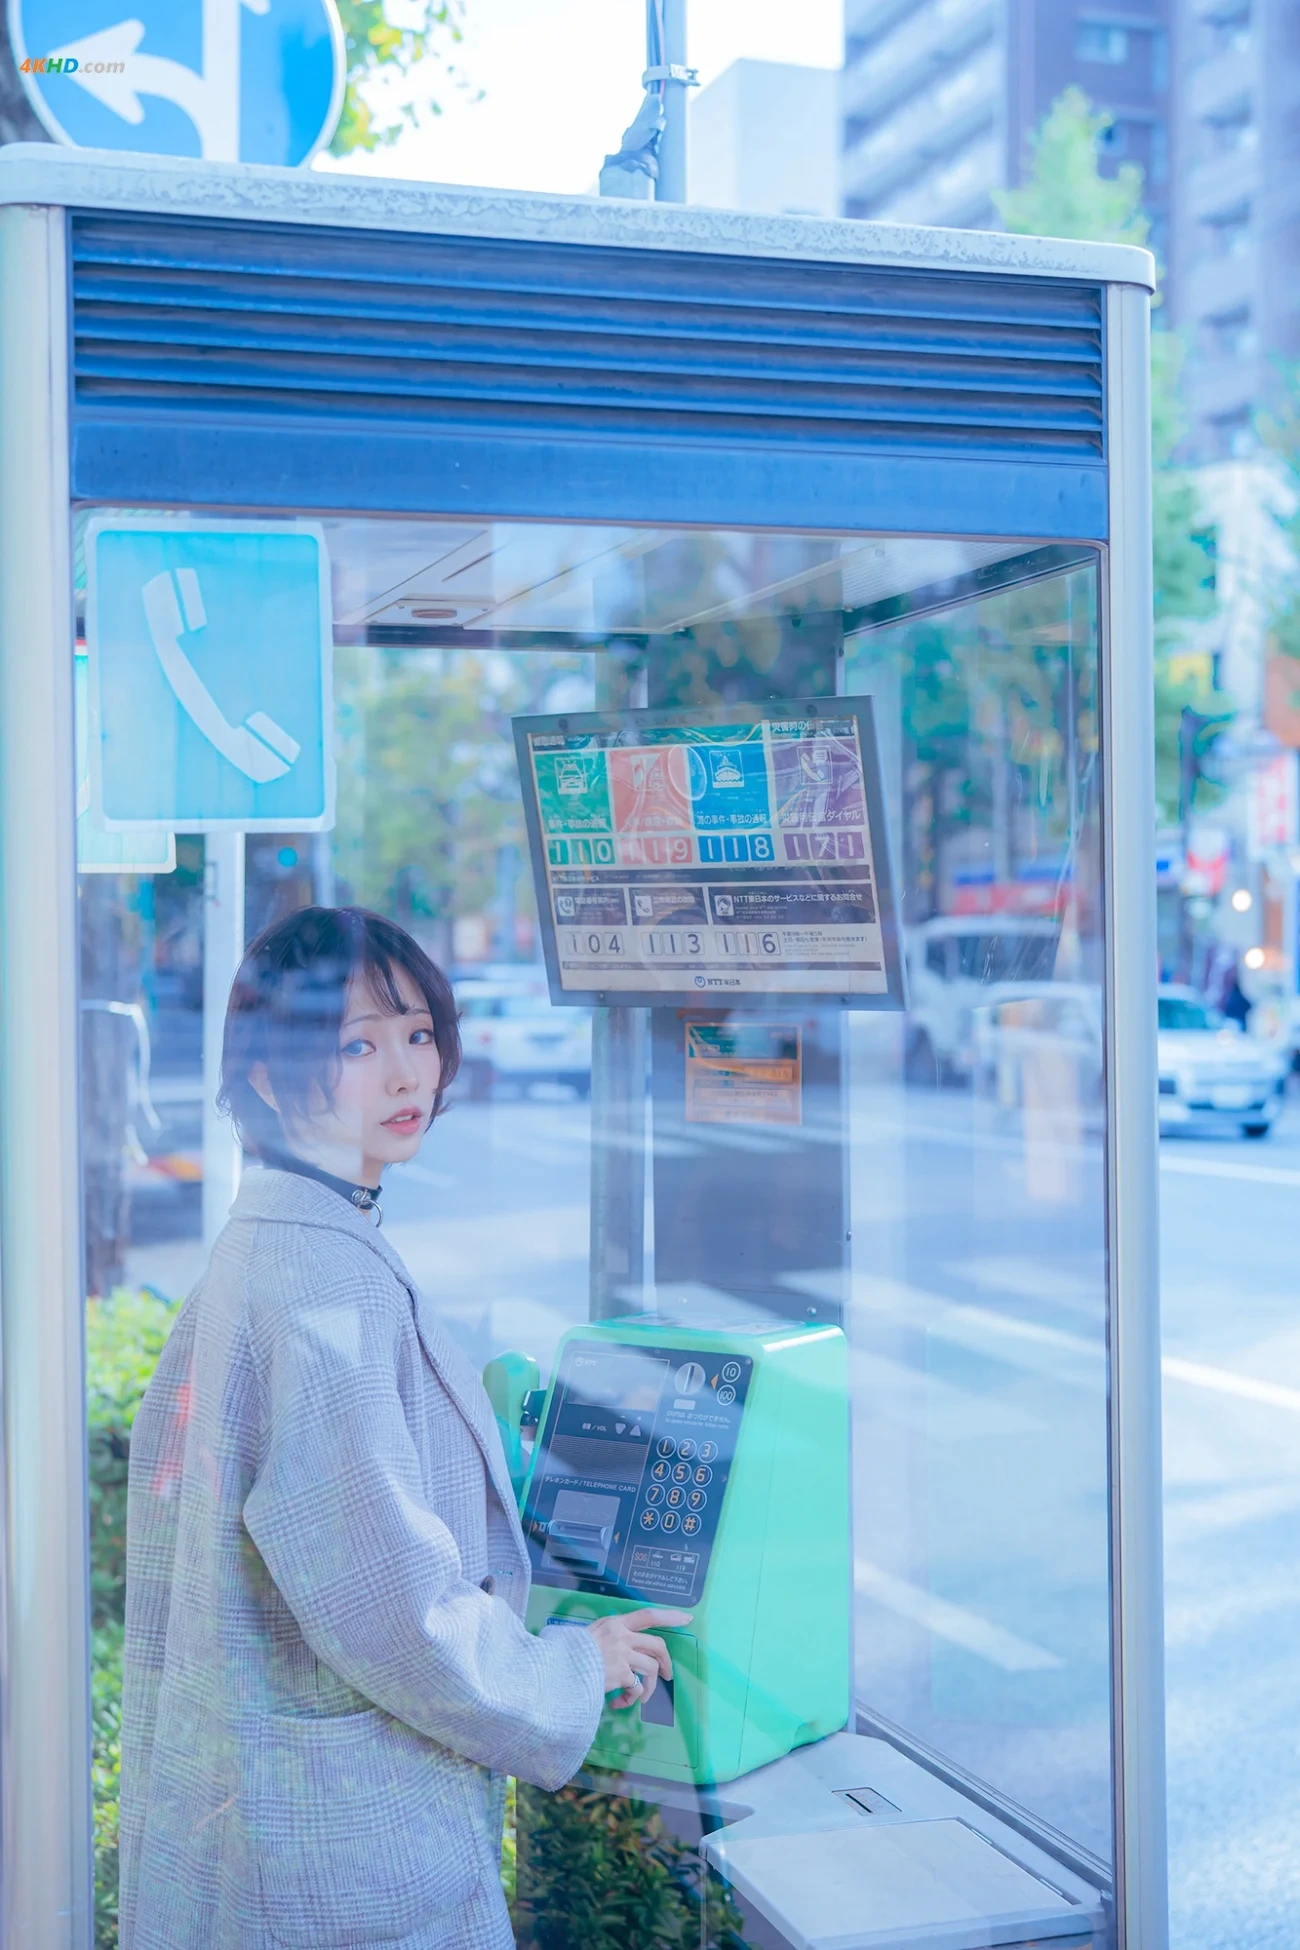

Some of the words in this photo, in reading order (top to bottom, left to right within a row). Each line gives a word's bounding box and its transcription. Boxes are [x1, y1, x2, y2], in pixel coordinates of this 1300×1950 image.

[555, 840, 612, 863] 110
[629, 838, 688, 861] 119
[707, 836, 770, 859] 118
[792, 833, 855, 858] 171
[571, 933, 621, 954] 104
[649, 933, 701, 954] 113
[723, 932, 776, 954] 116
[725, 1367, 737, 1377] 10
[719, 1390, 733, 1401] 100
[634, 1551, 648, 1562] SOS
